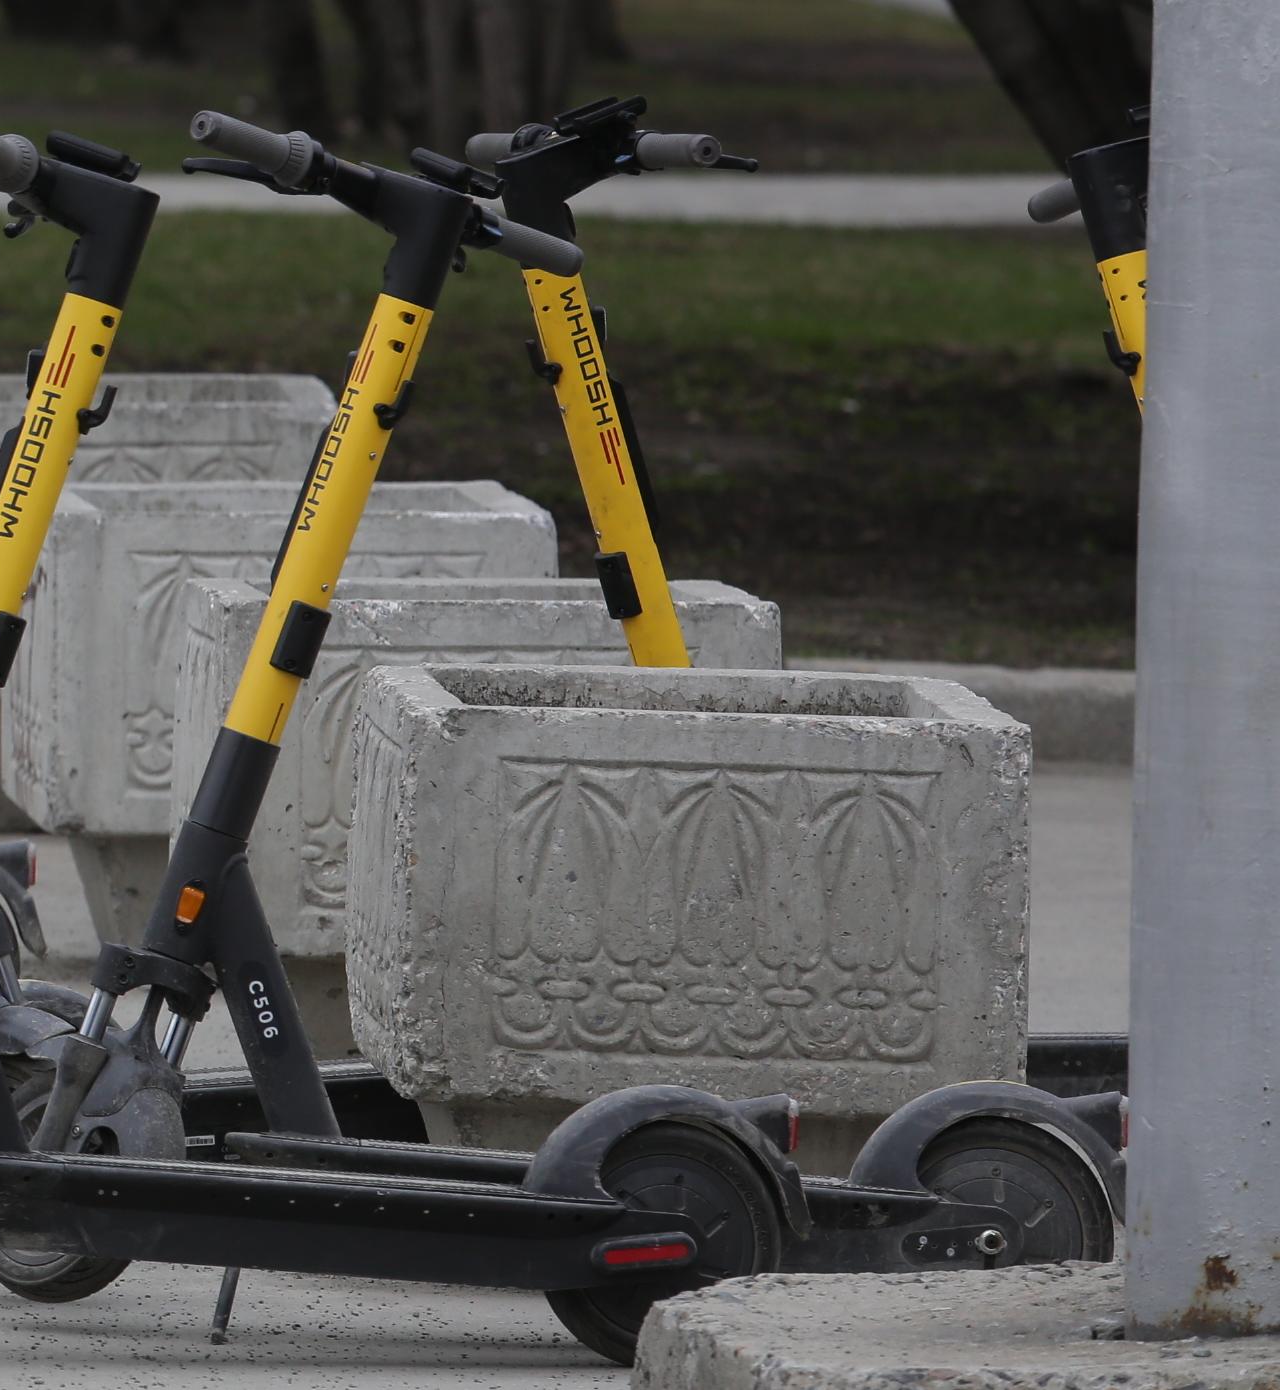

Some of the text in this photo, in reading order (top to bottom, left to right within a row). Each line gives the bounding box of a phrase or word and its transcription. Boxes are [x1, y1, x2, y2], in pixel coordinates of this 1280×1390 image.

[559, 286, 614, 427] WHOOSH
[297, 387, 360, 531] WHOOSH
[248, 980, 279, 1039] C506
